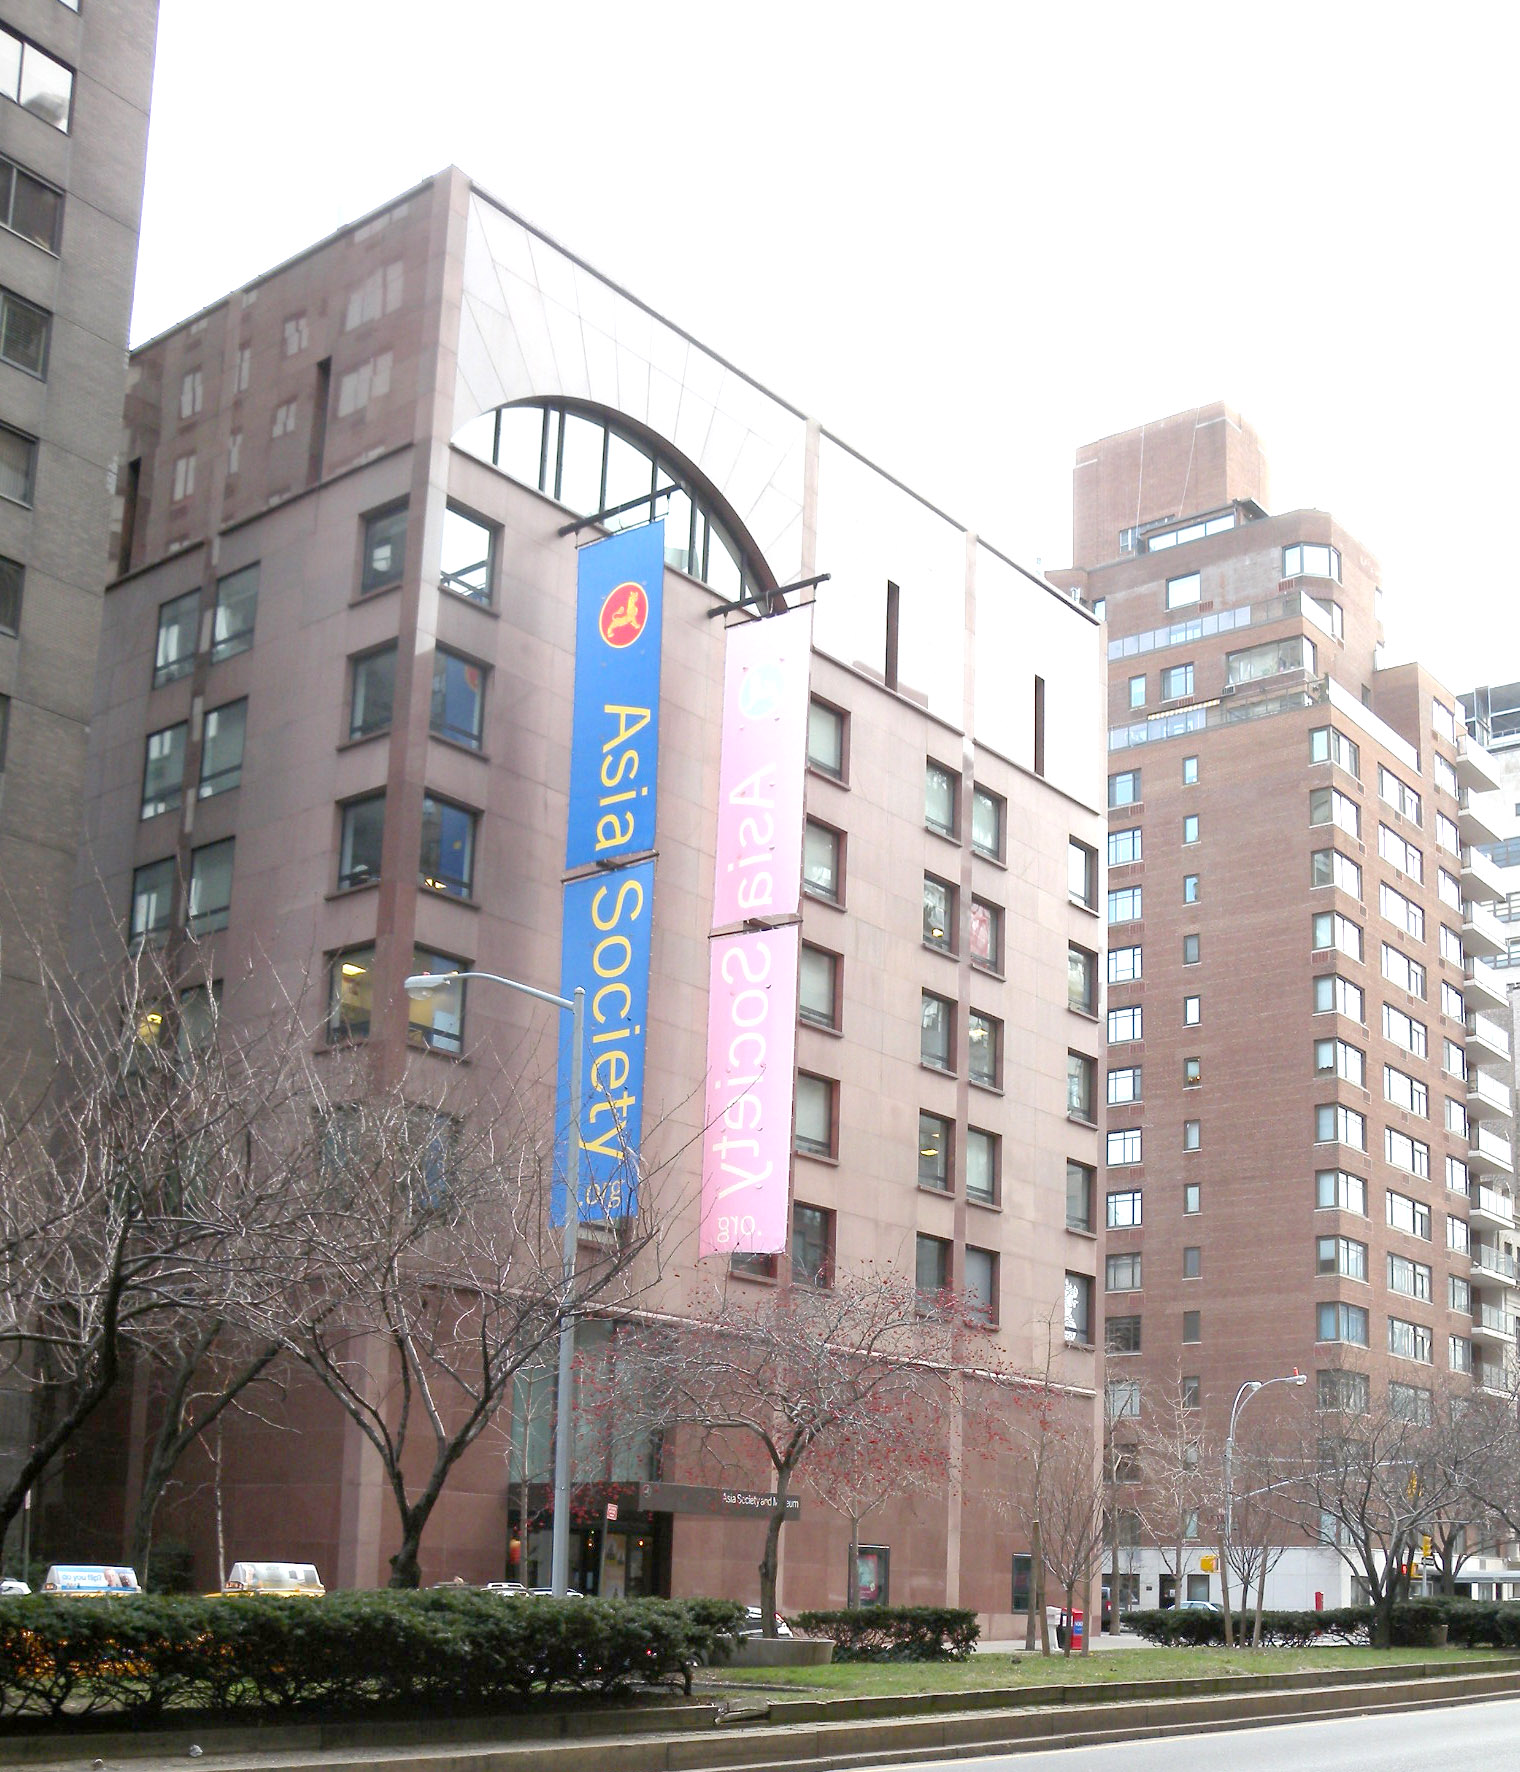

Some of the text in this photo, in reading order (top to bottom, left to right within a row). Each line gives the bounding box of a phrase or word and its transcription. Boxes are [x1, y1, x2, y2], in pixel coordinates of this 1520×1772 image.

[579, 704, 651, 1160] Asia Society
[760, 1496, 772, 1507] and
